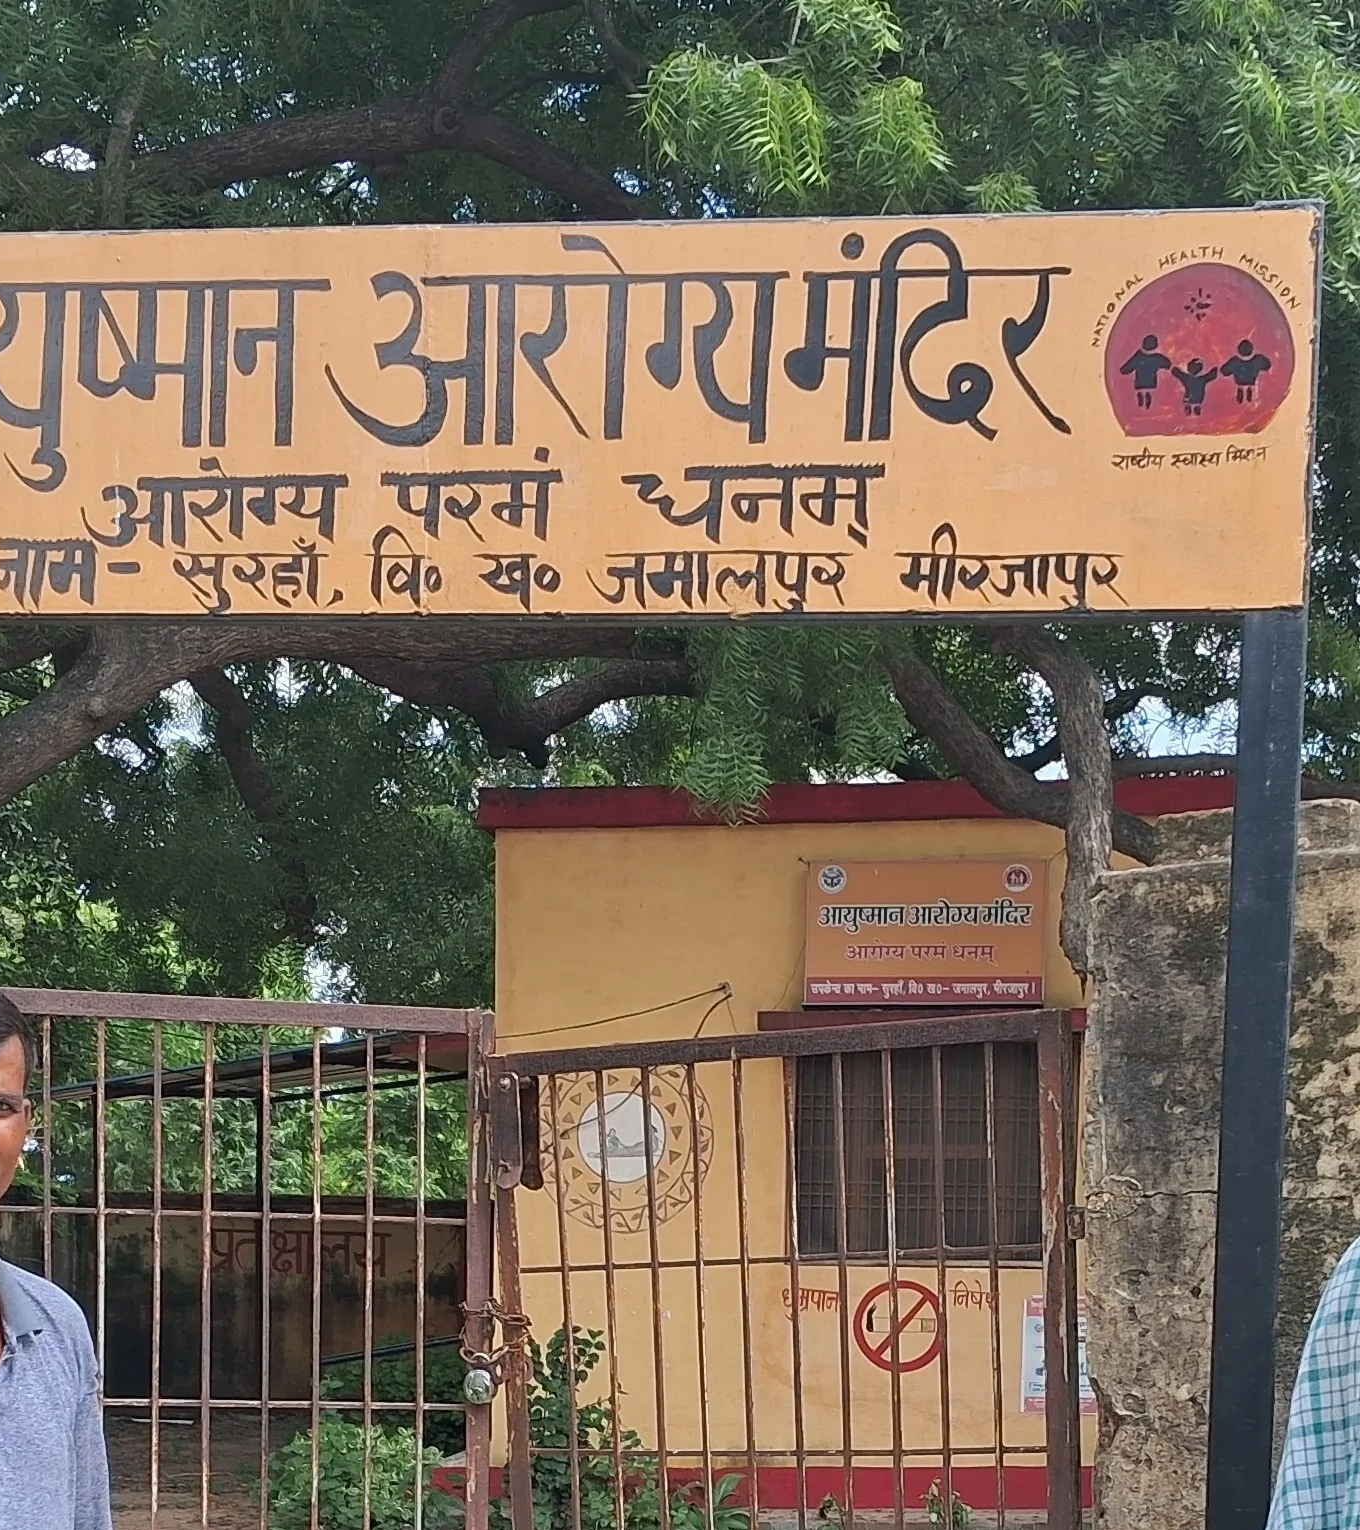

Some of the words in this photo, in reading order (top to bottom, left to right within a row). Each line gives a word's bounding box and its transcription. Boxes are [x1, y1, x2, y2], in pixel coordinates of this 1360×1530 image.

[1091, 274, 1144, 348] NATIONAL
[1158, 246, 1224, 270] HEALTH
[1239, 252, 1302, 313] MISSION
[81, 456, 350, 549] आरोग्य
[381, 446, 563, 543] परमं
[586, 549, 853, 612] जमालपुर
[895, 522, 1129, 612] मीरजापुर
[818, 904, 906, 933] आयुष्मान
[907, 898, 980, 926] आरोग्य
[982, 898, 1032, 926] मंदिर
[846, 939, 906, 961] आरोग्य
[910, 941, 947, 961] परमं
[953, 944, 998, 966] धनम्
